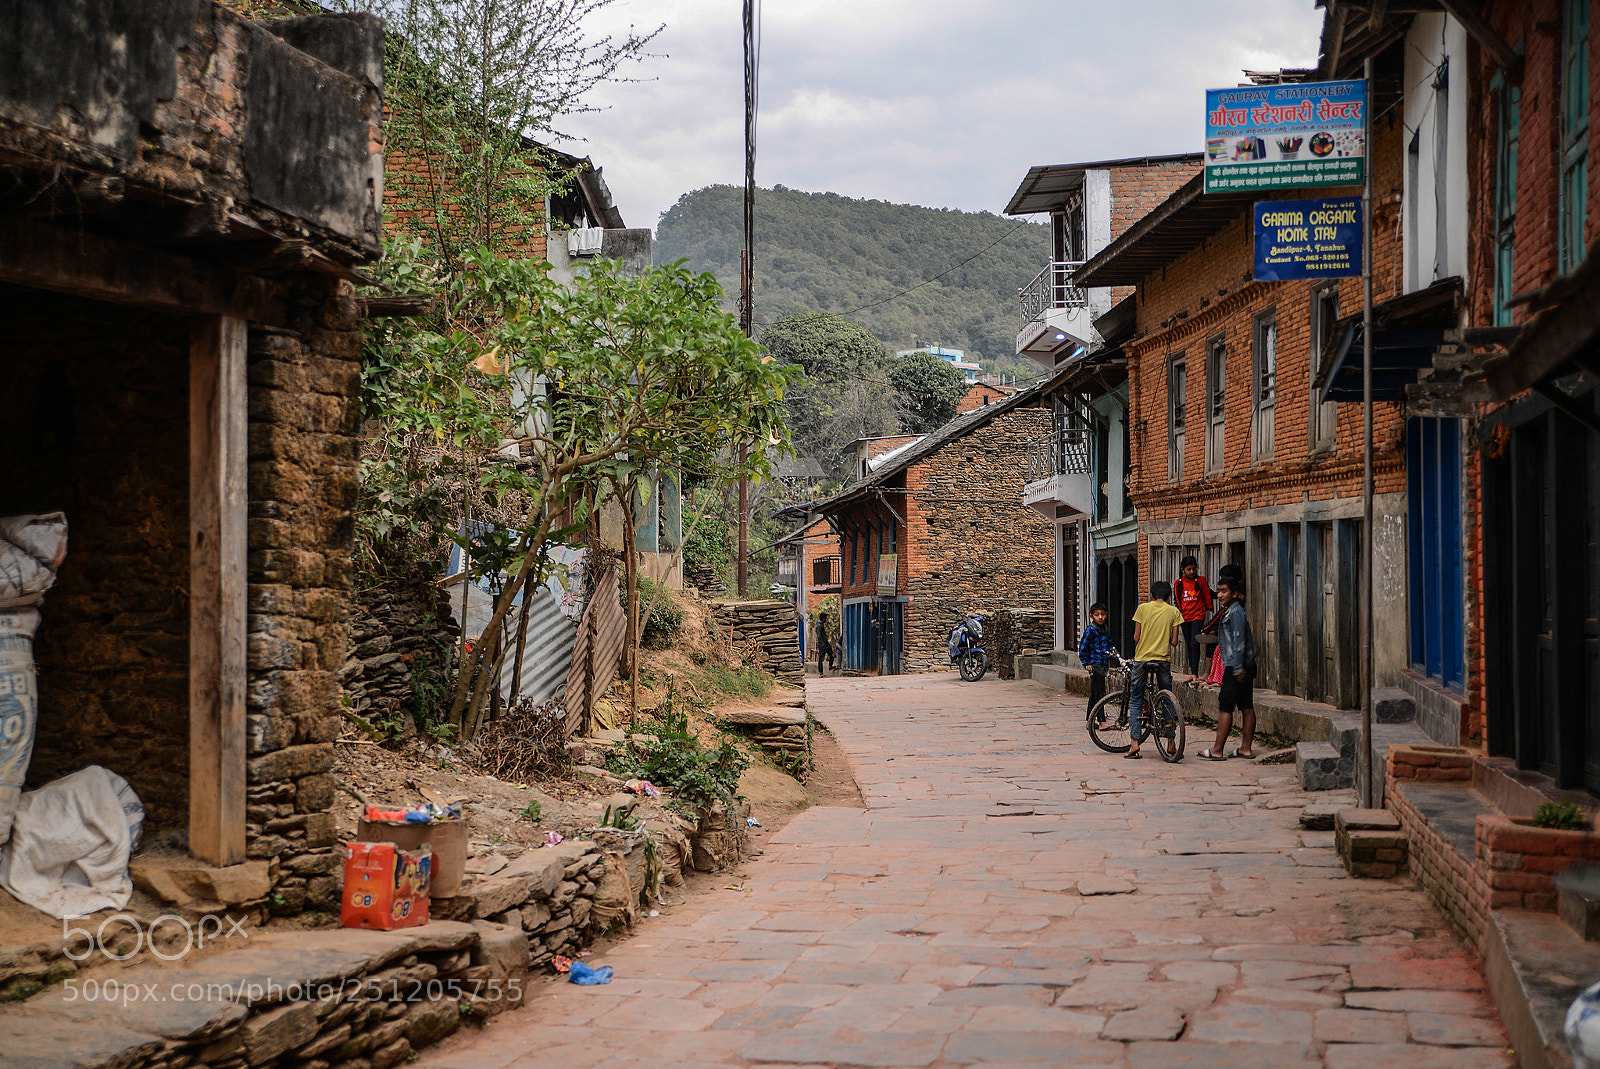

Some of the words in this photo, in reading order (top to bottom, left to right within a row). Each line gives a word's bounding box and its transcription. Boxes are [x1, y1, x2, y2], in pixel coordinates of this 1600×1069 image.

[1218, 90, 1269, 103] GAURAV
[1275, 85, 1353, 100] STATIONERY
[1209, 104, 1248, 127] गौरव
[1251, 100, 1313, 125] स्टेशनरी
[1317, 98, 1363, 121] सेन्टर
[1309, 209, 1357, 225] ORGANIC
[1277, 227, 1308, 243] HOME
[1314, 226, 1337, 241] STAY
[1265, 256, 1292, 264] Contact
